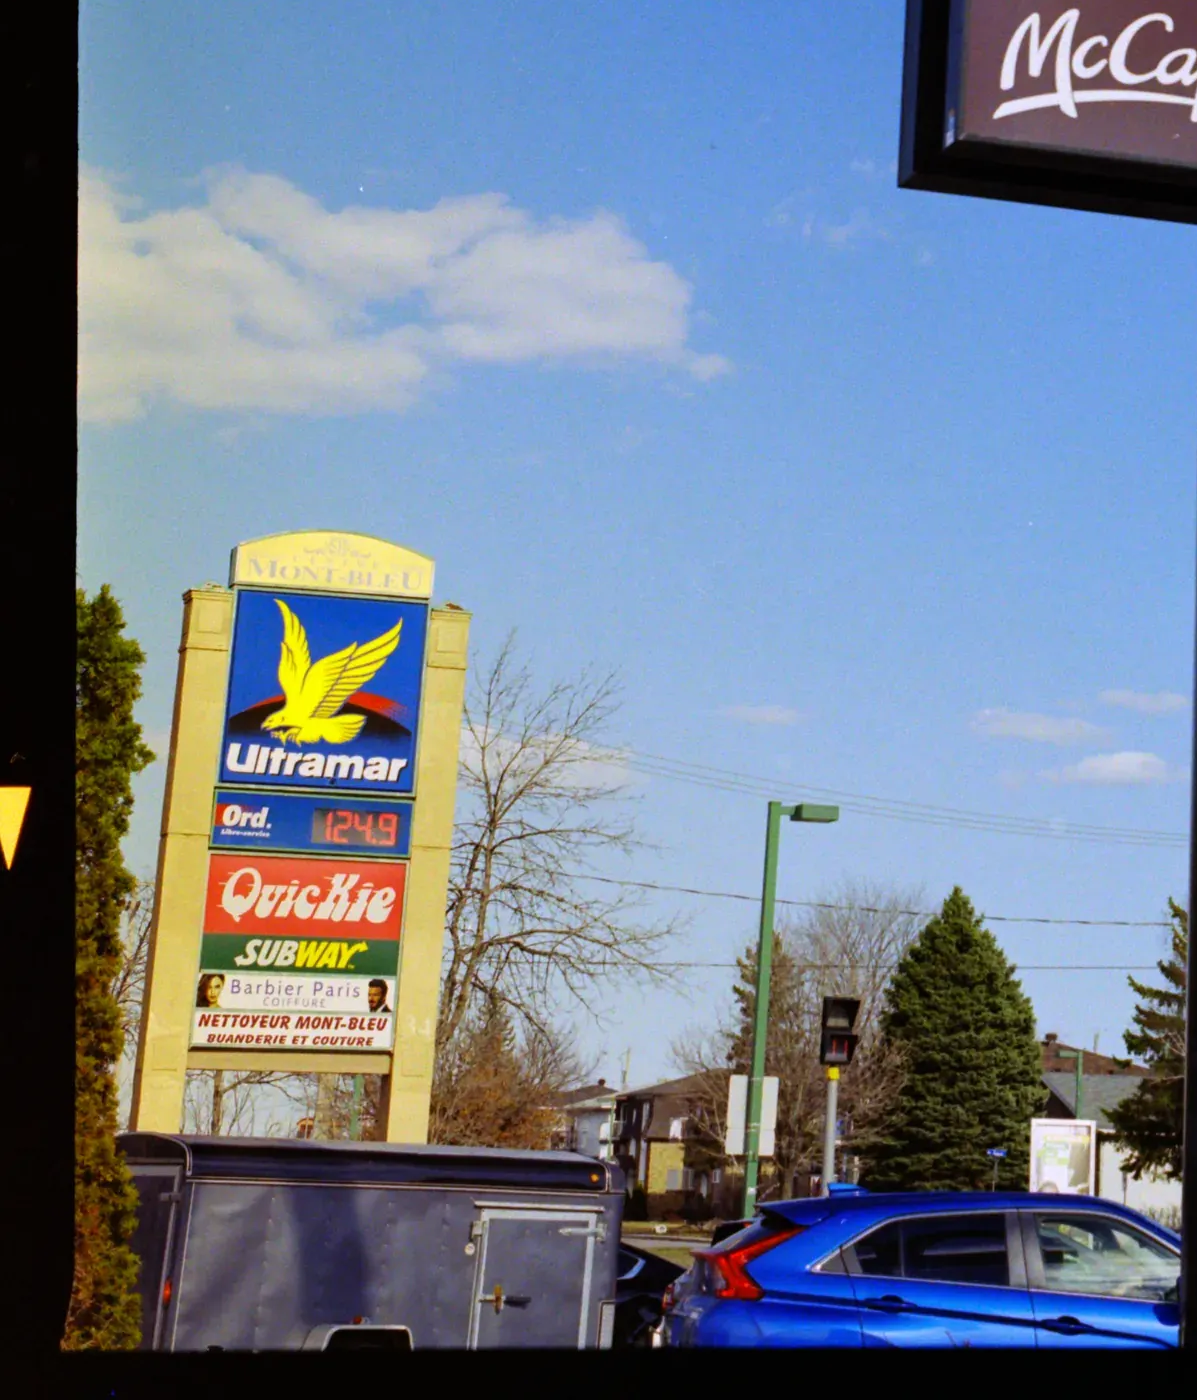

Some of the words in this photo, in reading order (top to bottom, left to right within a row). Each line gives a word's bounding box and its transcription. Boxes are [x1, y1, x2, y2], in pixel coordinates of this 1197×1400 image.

[226, 743, 408, 782] Ultramar
[222, 804, 272, 829] Ord.
[234, 939, 369, 969] SUBWAY
[230, 979, 303, 996] Barbier
[312, 983, 361, 998] Paris
[262, 996, 326, 1008] COIFFURE
[198, 1014, 291, 1030] NETTOYEUR
[294, 1016, 388, 1031] MONT-BLEU
[206, 1034, 287, 1045] BUANDERIE
[291, 1035, 309, 1046] ET
[312, 1035, 374, 1047] COUTURE
